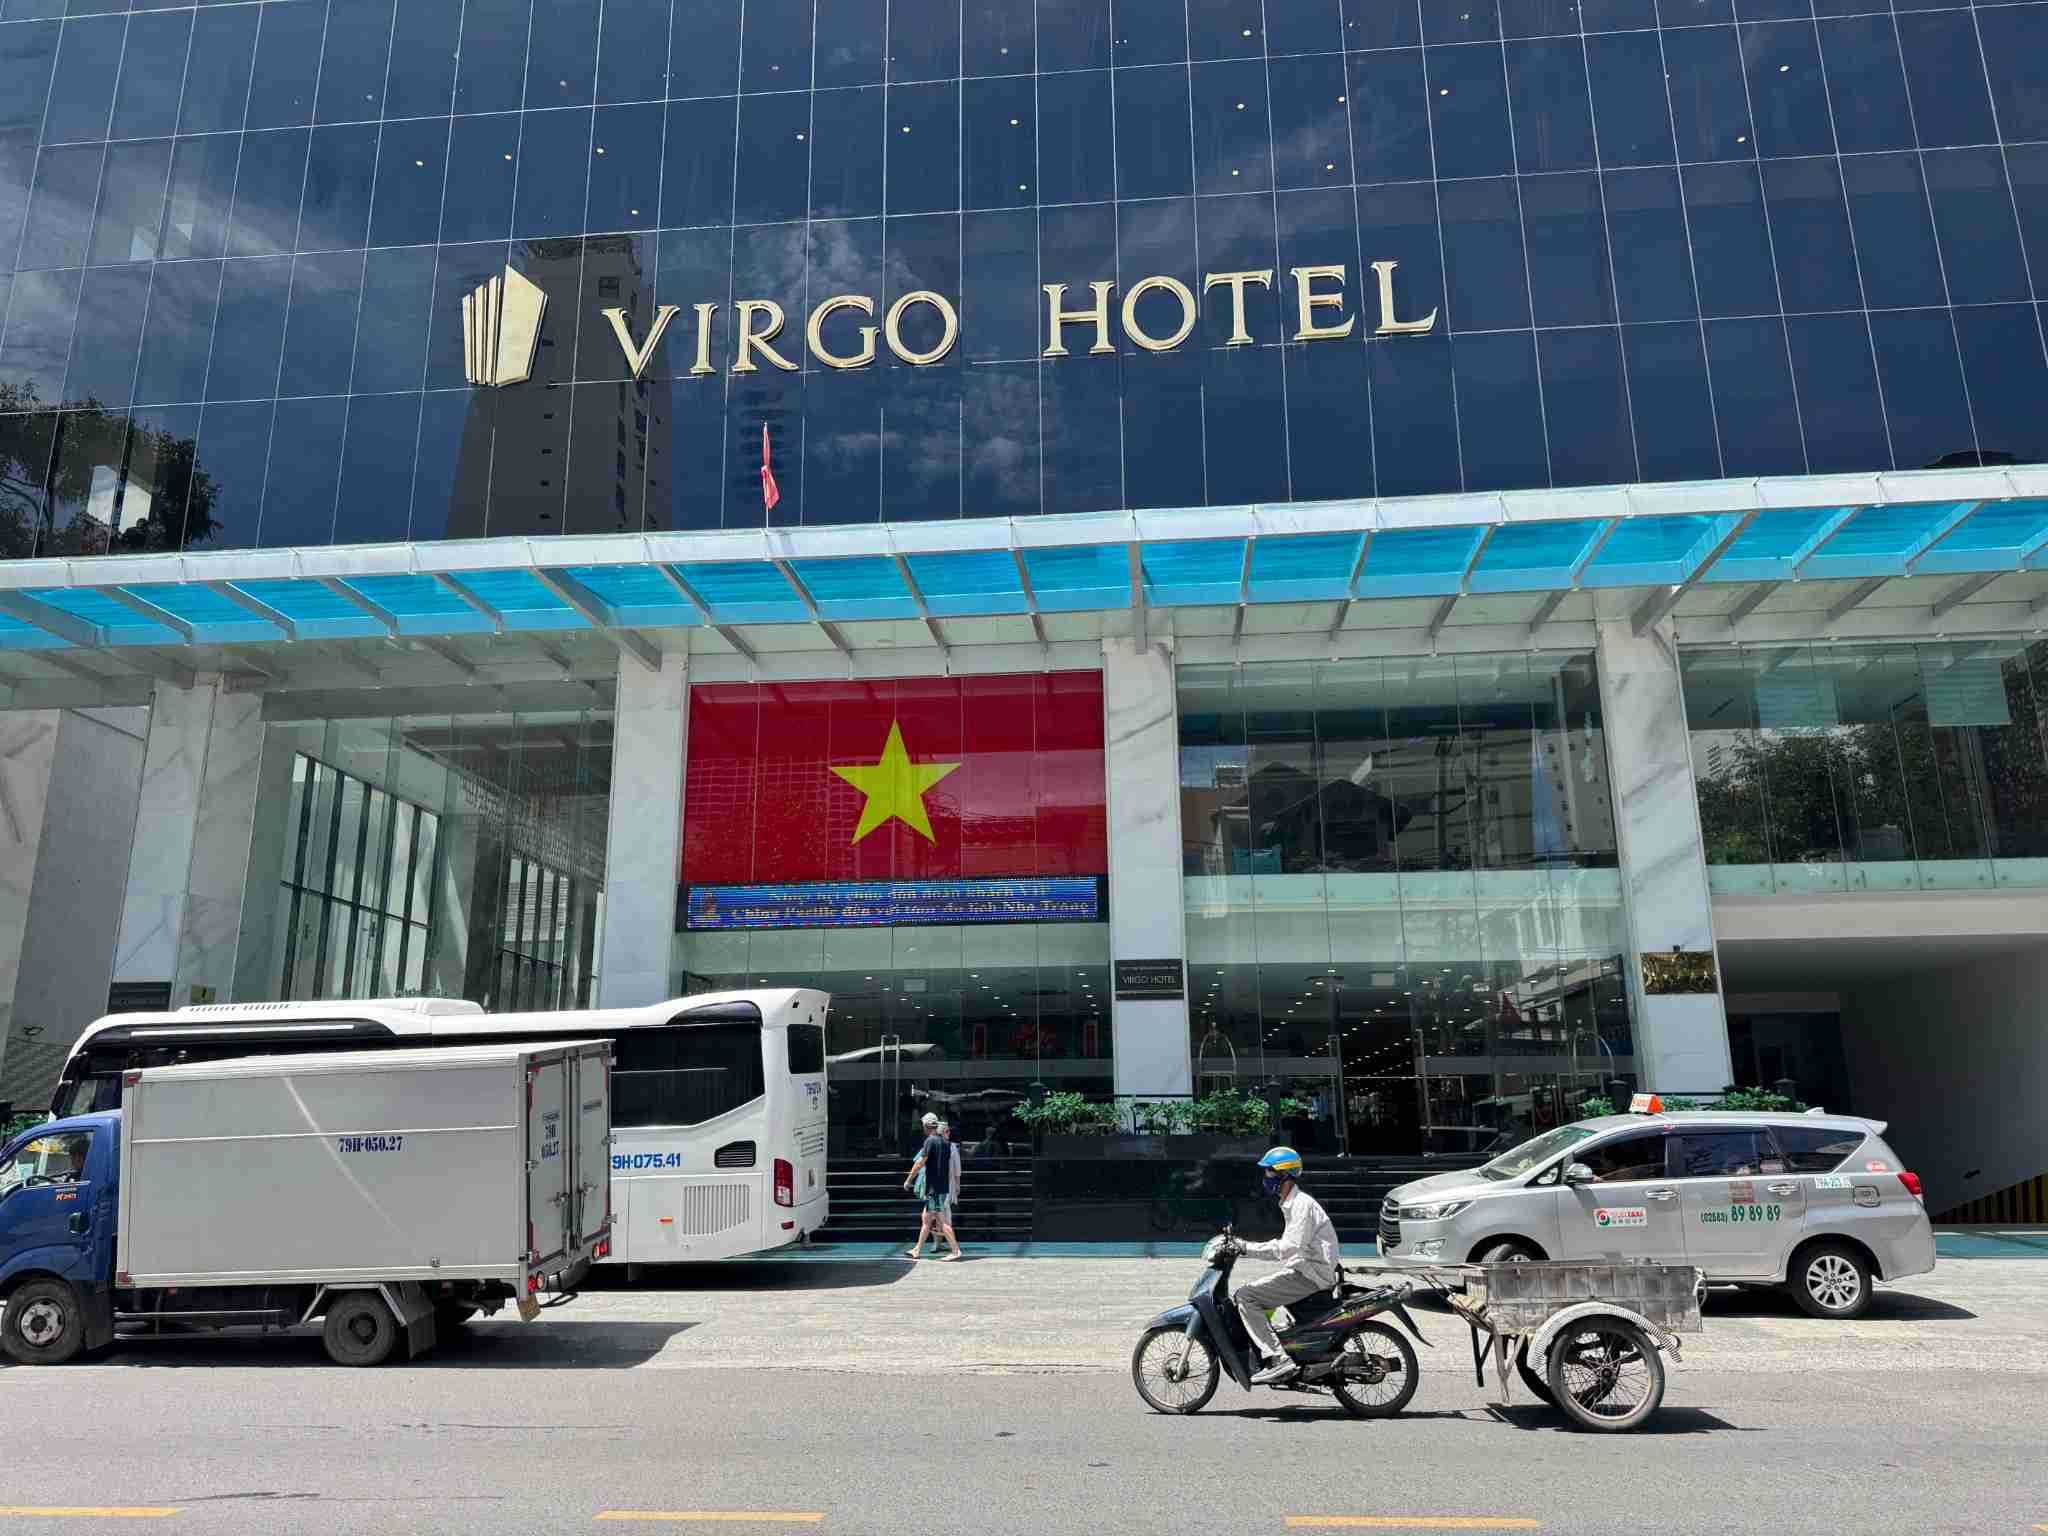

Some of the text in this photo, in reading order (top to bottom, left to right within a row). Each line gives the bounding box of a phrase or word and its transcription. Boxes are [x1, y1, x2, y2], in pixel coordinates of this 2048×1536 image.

[602, 260, 1438, 378] VIRGO HOTEL
[1002, 899, 1035, 912] Nha
[1040, 898, 1090, 914] Trang
[1152, 975, 1177, 985] HOTEL
[338, 1135, 403, 1152] 79H-050.27
[1731, 1205, 1745, 1221] 89
[1748, 1205, 1763, 1221] 89
[1766, 1204, 1781, 1220] 89
